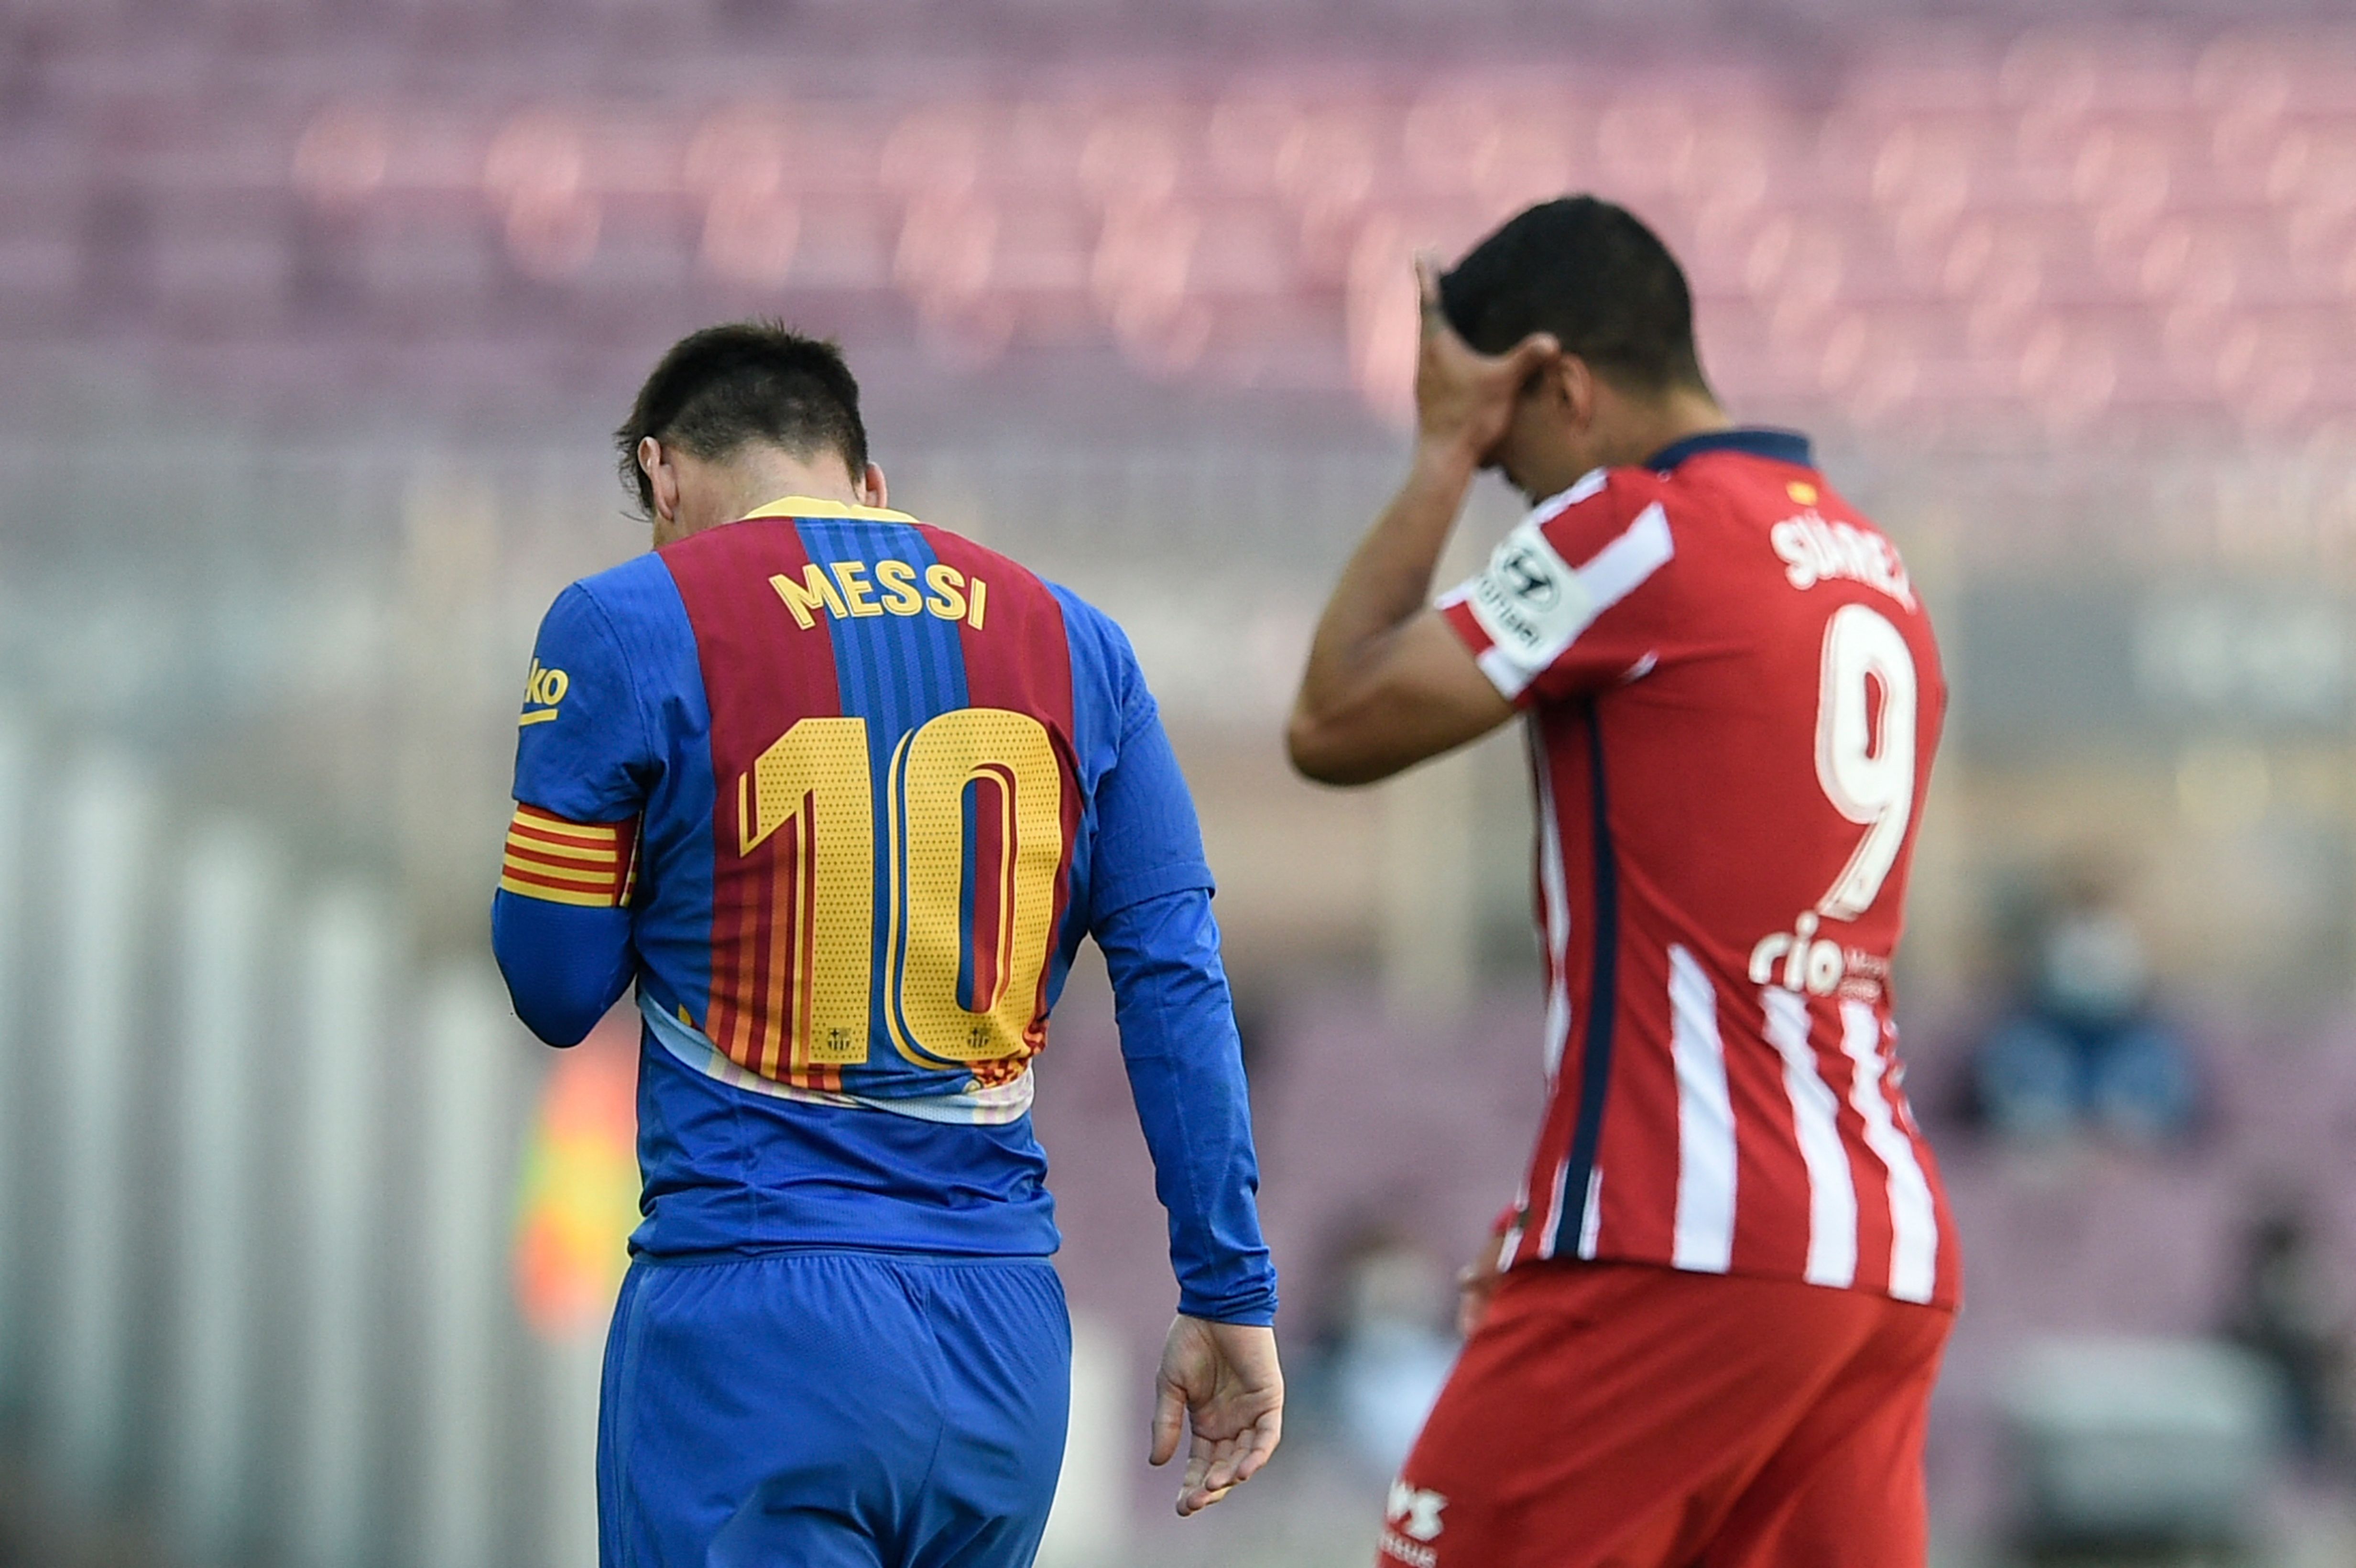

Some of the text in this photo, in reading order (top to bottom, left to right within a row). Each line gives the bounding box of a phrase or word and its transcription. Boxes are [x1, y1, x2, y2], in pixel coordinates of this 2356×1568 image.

[769, 560, 986, 631] MESSI
[739, 708, 1062, 1070] 10
[1815, 603, 1917, 922] 9
